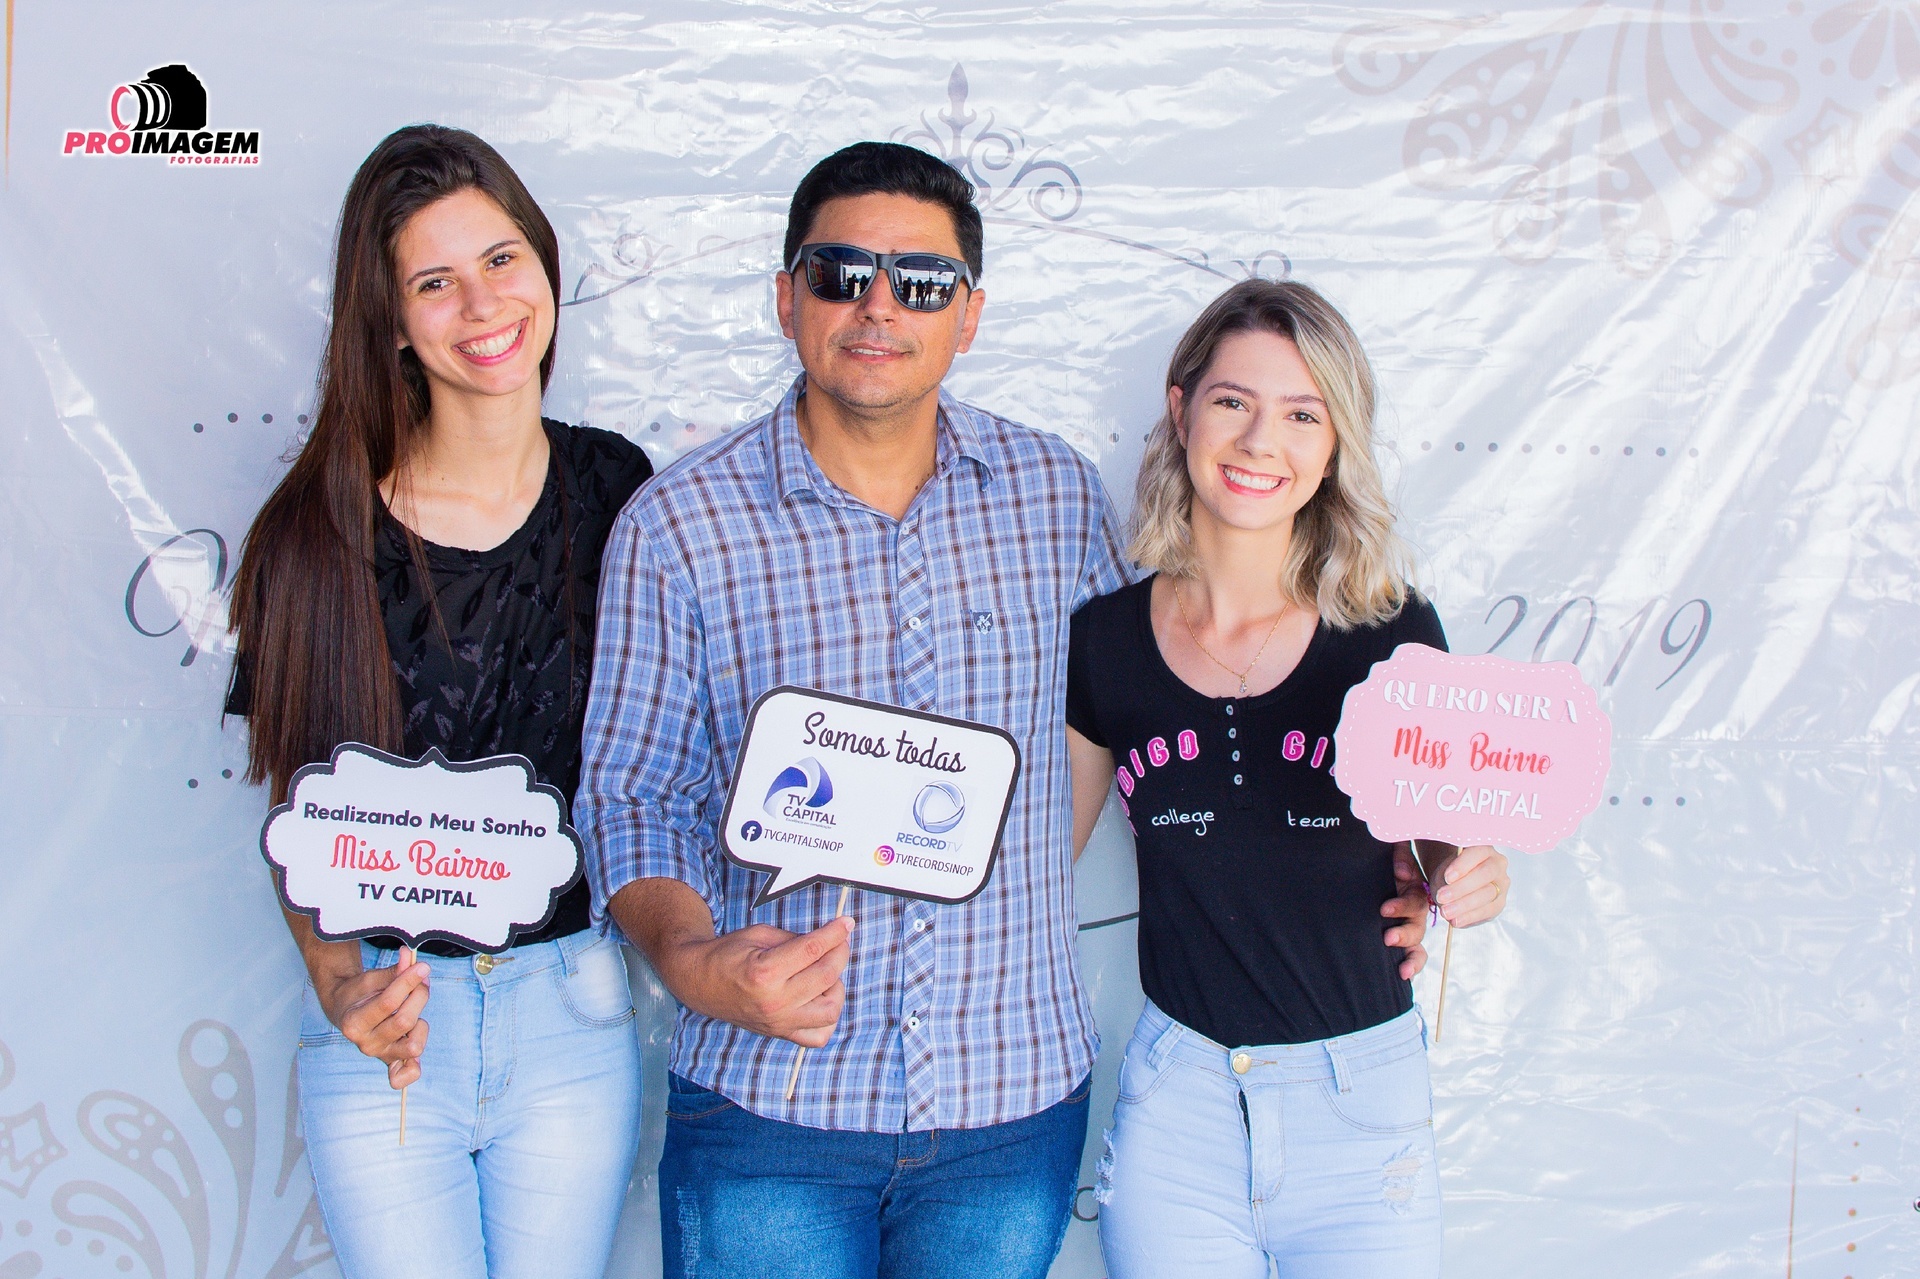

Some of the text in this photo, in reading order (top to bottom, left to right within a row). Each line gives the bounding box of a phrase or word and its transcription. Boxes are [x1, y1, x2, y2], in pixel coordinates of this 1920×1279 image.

[1484, 594, 1712, 690] 2019
[1383, 679, 1578, 723] QUERO SER A
[803, 711, 966, 773] Somos todas
[1393, 725, 1554, 775] Miss Bairro
[783, 806, 837, 825] CAPITAL
[788, 794, 806, 806] TV
[1394, 779, 1542, 820] TV CAPITAL
[303, 802, 547, 838] Realizando Meu Sonho
[1151, 808, 1341, 836] college team
[330, 833, 511, 881] Miss Bairro
[764, 828, 844, 852] TVCAPITALSINOP
[896, 853, 974, 876] TVRECORDSINOP
[357, 882, 478, 908] TV CAPITAL
